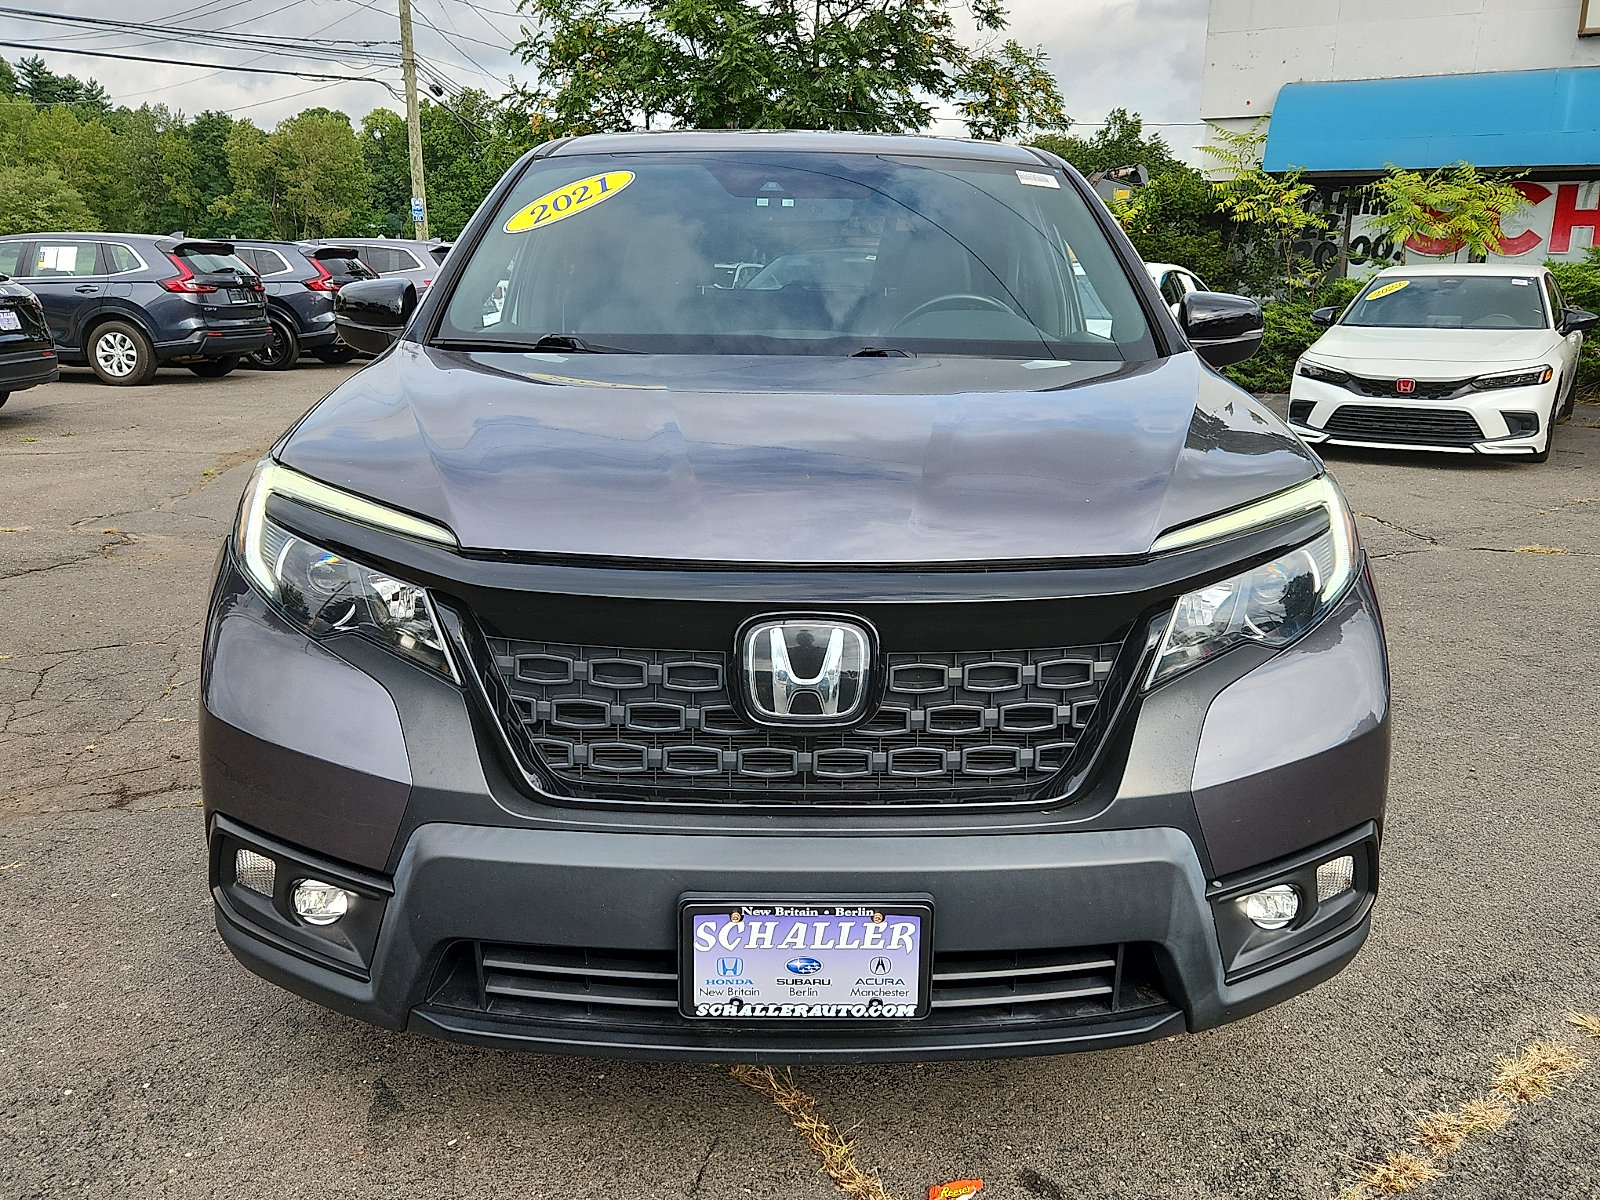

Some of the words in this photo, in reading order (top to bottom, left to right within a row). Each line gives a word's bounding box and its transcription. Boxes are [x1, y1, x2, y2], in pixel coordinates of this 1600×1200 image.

[530, 176, 613, 225] 2021
[741, 906, 772, 916] New
[775, 906, 819, 917] Britain
[834, 907, 875, 917] Berlin
[695, 921, 916, 955] SCHALLER
[776, 978, 831, 986] SUBARU
[854, 978, 906, 986] ACURA
[699, 987, 725, 997] New
[727, 987, 760, 997] Britain
[789, 987, 819, 997] Berlin
[850, 987, 910, 998] Manchester
[695, 1003, 918, 1018] SCHALLERAUTO.COM
